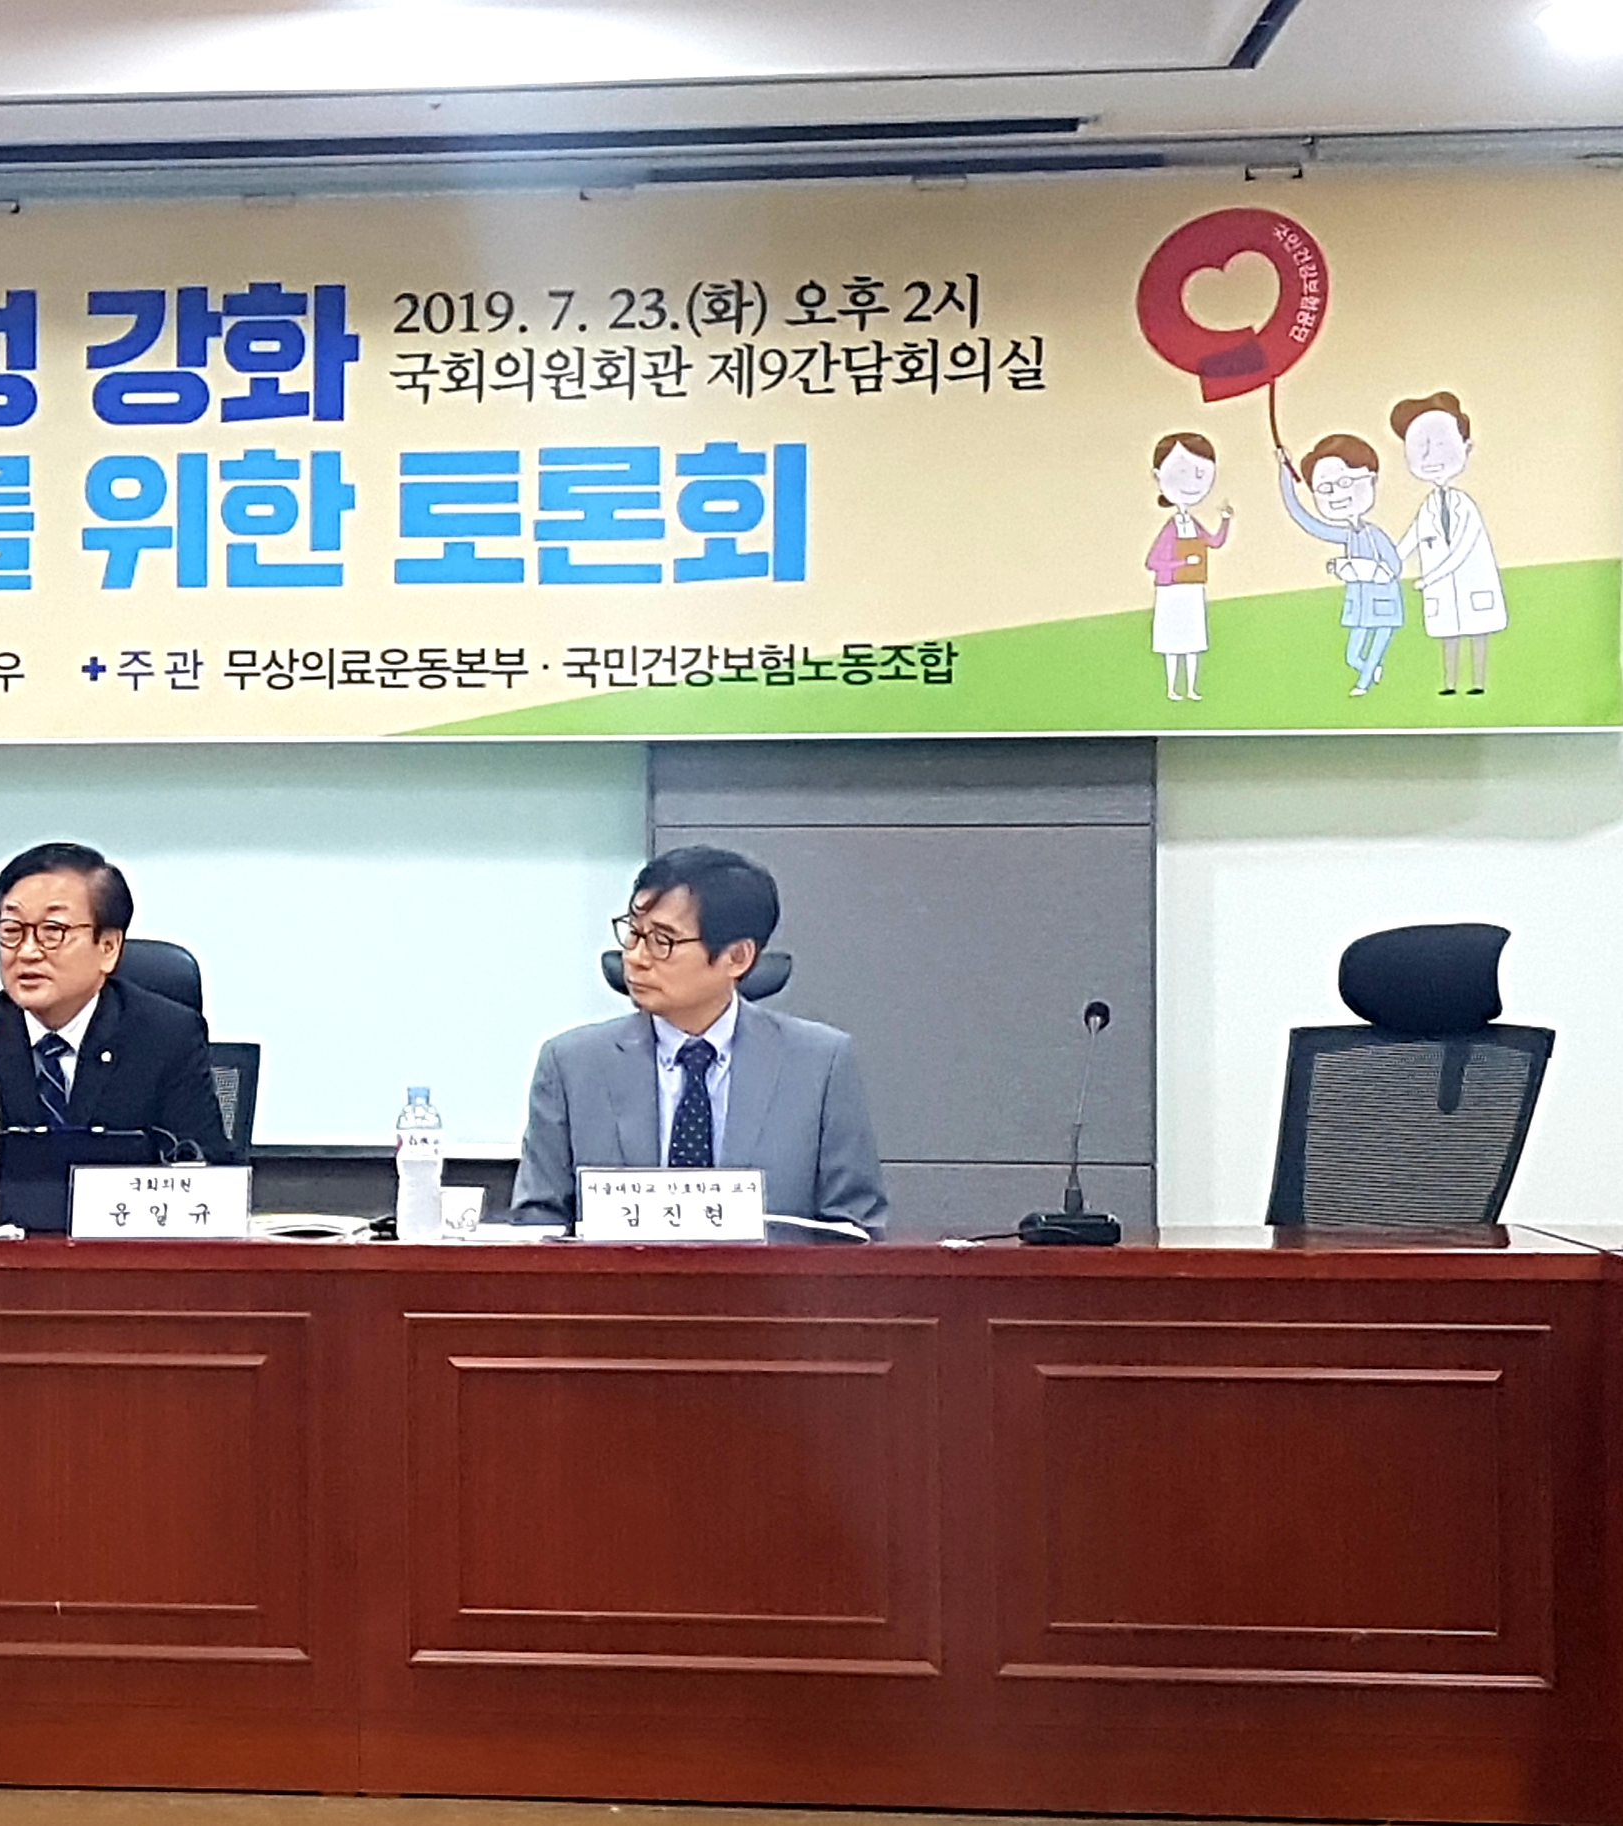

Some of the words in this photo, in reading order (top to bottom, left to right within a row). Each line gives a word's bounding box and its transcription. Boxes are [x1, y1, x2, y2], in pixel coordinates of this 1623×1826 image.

[392, 289, 529, 335] 2019.
[548, 289, 589, 333] 7.
[607, 278, 769, 337] 23.(화)
[783, 275, 891, 330] 오후
[901, 272, 981, 329] 2시
[85, 281, 360, 426] 강화
[388, 343, 693, 404] 국회의원회관
[708, 335, 1048, 399] 제9간담회의실
[81, 448, 357, 590] 위한
[393, 441, 808, 586] 토론회
[223, 647, 529, 690] 무상의료운동본부
[561, 641, 960, 689] 국민건강보험노동조합
